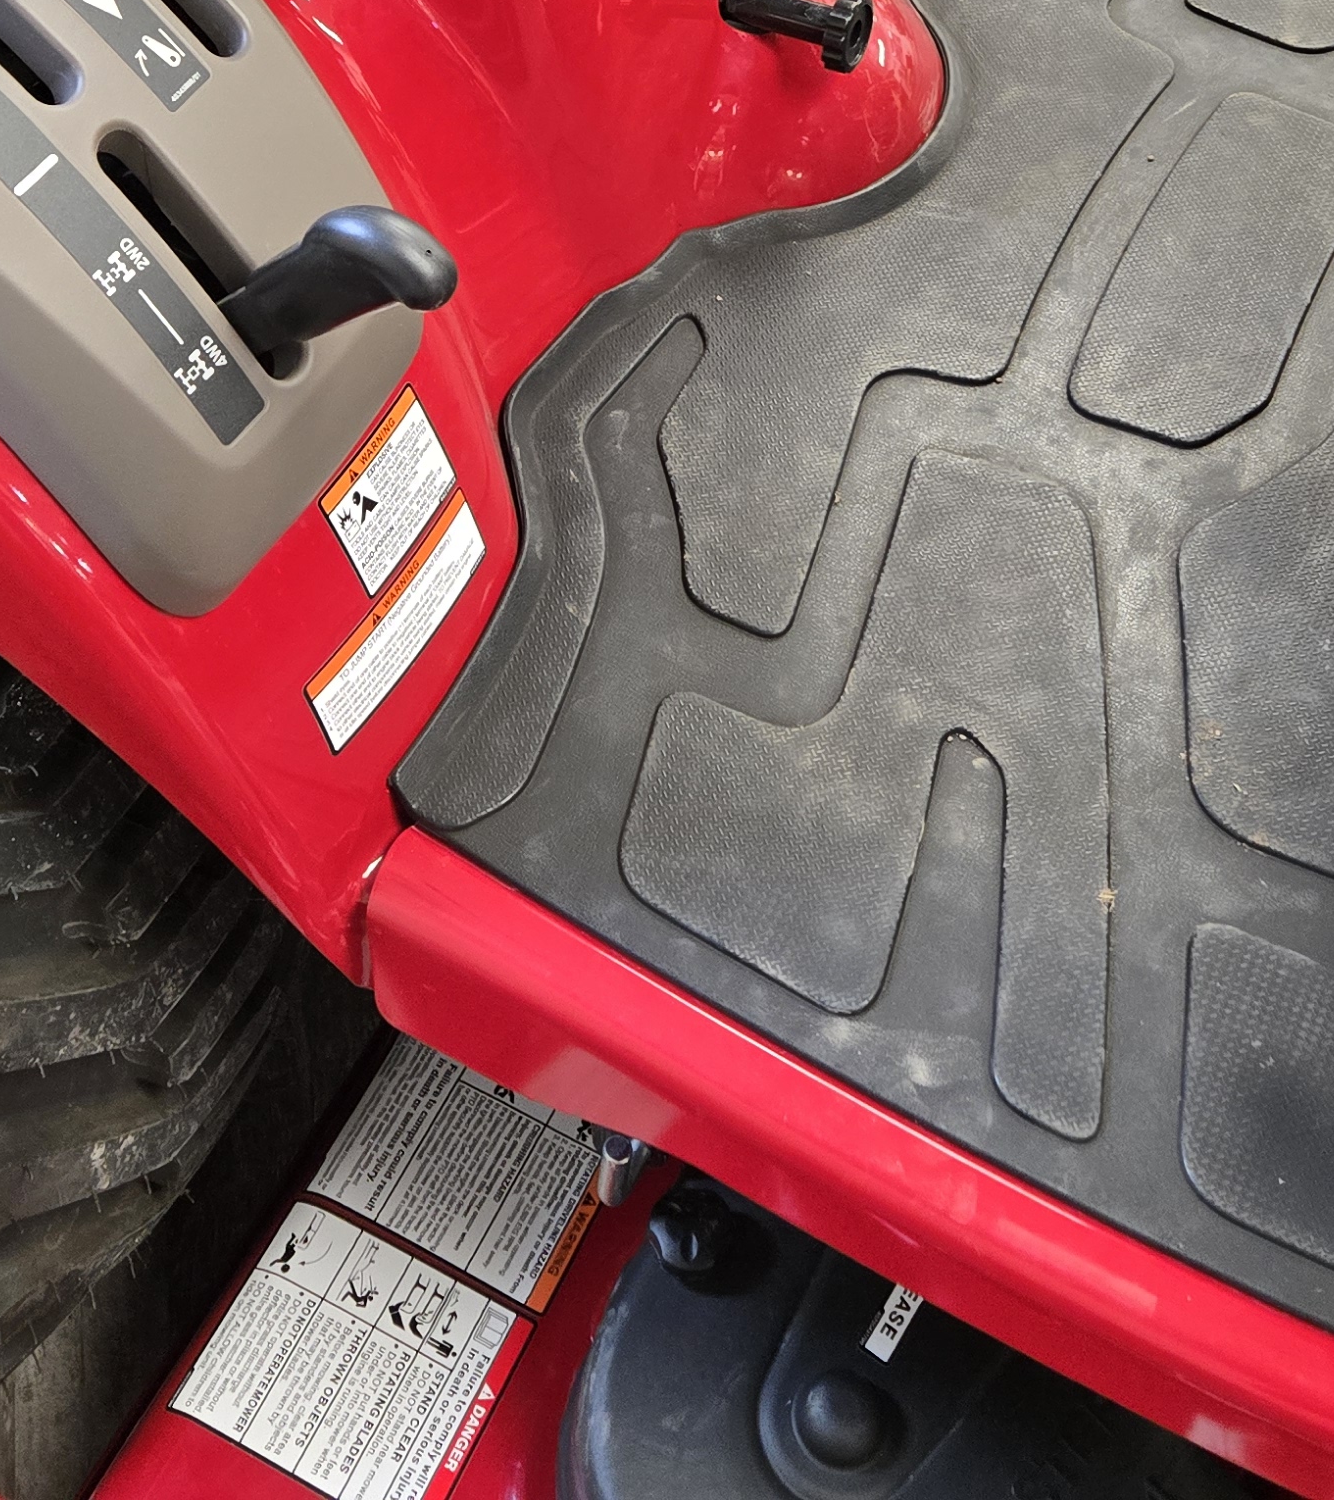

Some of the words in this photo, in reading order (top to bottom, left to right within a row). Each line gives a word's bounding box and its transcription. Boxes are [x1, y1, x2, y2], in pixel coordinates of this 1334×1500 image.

[119, 237, 151, 271] 2WD
[199, 335, 228, 367] 4WD
[359, 415, 395, 466] WARNING
[381, 557, 420, 611] WARNING
[431, 1062, 456, 1098] Failure
[424, 1097, 436, 1110] to
[399, 1108, 429, 1149] comply
[383, 1147, 406, 1180] could
[364, 1179, 388, 1212] result
[547, 1209, 588, 1277] WARNING
[300, 1298, 317, 1317] DO
[286, 1315, 307, 1340] NOT
[256, 1338, 293, 1391] OPERATE
[329, 1327, 368, 1385] THROWN
[380, 1349, 397, 1369] DO
[366, 1368, 387, 1394] NOT
[367, 1350, 411, 1419] ROTATING
[401, 1364, 422, 1393] when
[414, 1369, 431, 1389] DO
[445, 1361, 472, 1399] death
[460, 1353, 491, 1398] Failure
[353, 1391, 373, 1413] put
[393, 1393, 406, 1405] in
[400, 1387, 421, 1414] NOT
[414, 1370, 445, 1416] STAND
[437, 1400, 451, 1414] or
[452, 1398, 467, 1414] to
[231, 1388, 263, 1433] MOWER
[292, 1385, 334, 1448] OBJECTS
[338, 1411, 362, 1444] hands
[362, 1404, 400, 1459] operation.
[384, 1412, 407, 1444] stand
[389, 1416, 421, 1463] CLEAR
[409, 1415, 443, 1465] serious
[425, 1413, 458, 1462] comply
[442, 1403, 487, 1473] DANGER
[330, 1444, 344, 1459] or
[336, 1418, 374, 1474] BLADES
[371, 1443, 391, 1468] near
[318, 1457, 337, 1480] feet
[413, 1463, 433, 1488] will
